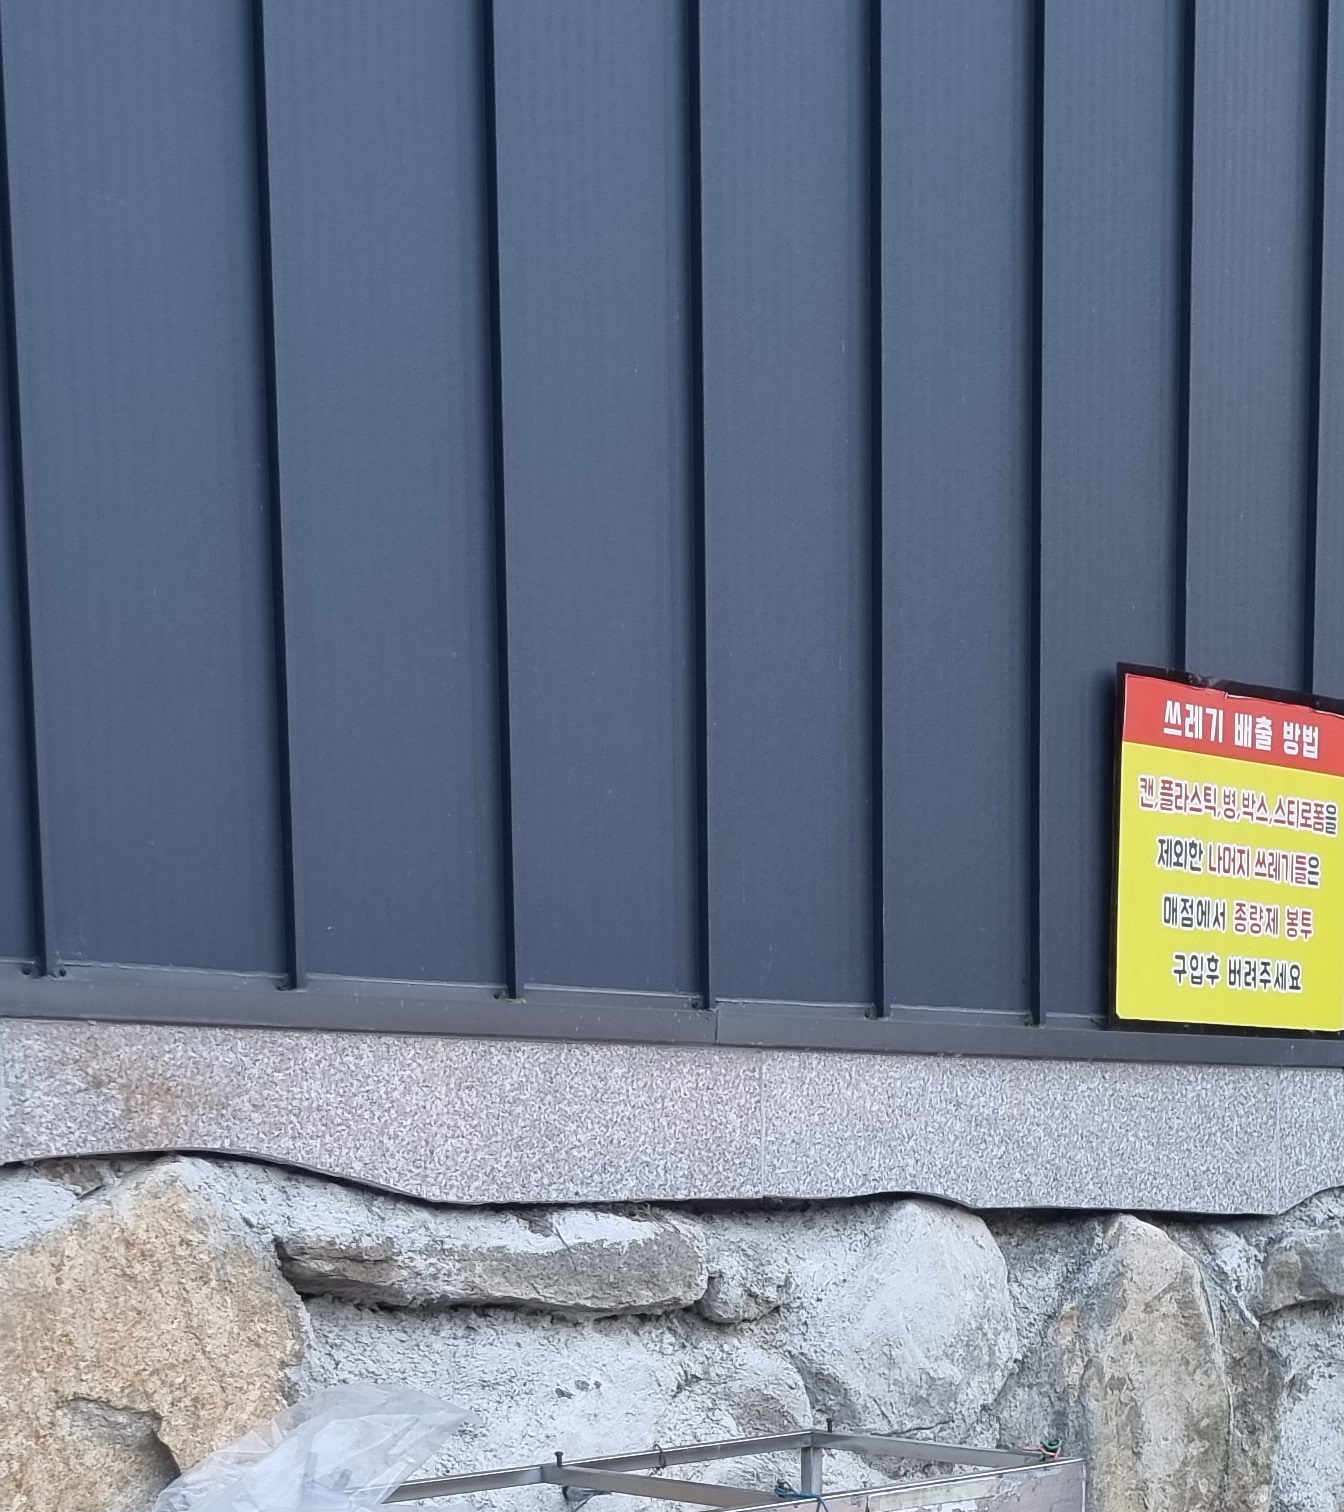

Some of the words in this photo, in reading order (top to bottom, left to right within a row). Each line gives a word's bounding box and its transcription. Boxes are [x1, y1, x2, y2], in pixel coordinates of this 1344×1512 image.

[1163, 700, 1224, 743] 쓰레기
[1234, 712, 1273, 751] 배출
[1283, 721, 1319, 759] 방법
[1157, 838, 1203, 873] 제외한
[1208, 844, 1250, 879] 나머지
[1255, 851, 1320, 887] 쓰레기들은
[1163, 896, 1226, 931] 매점에서
[1234, 902, 1279, 936] 종량제
[1285, 908, 1313, 940] 봉투
[1173, 954, 1220, 986] 구입후
[1228, 958, 1302, 992] 버려주세요
